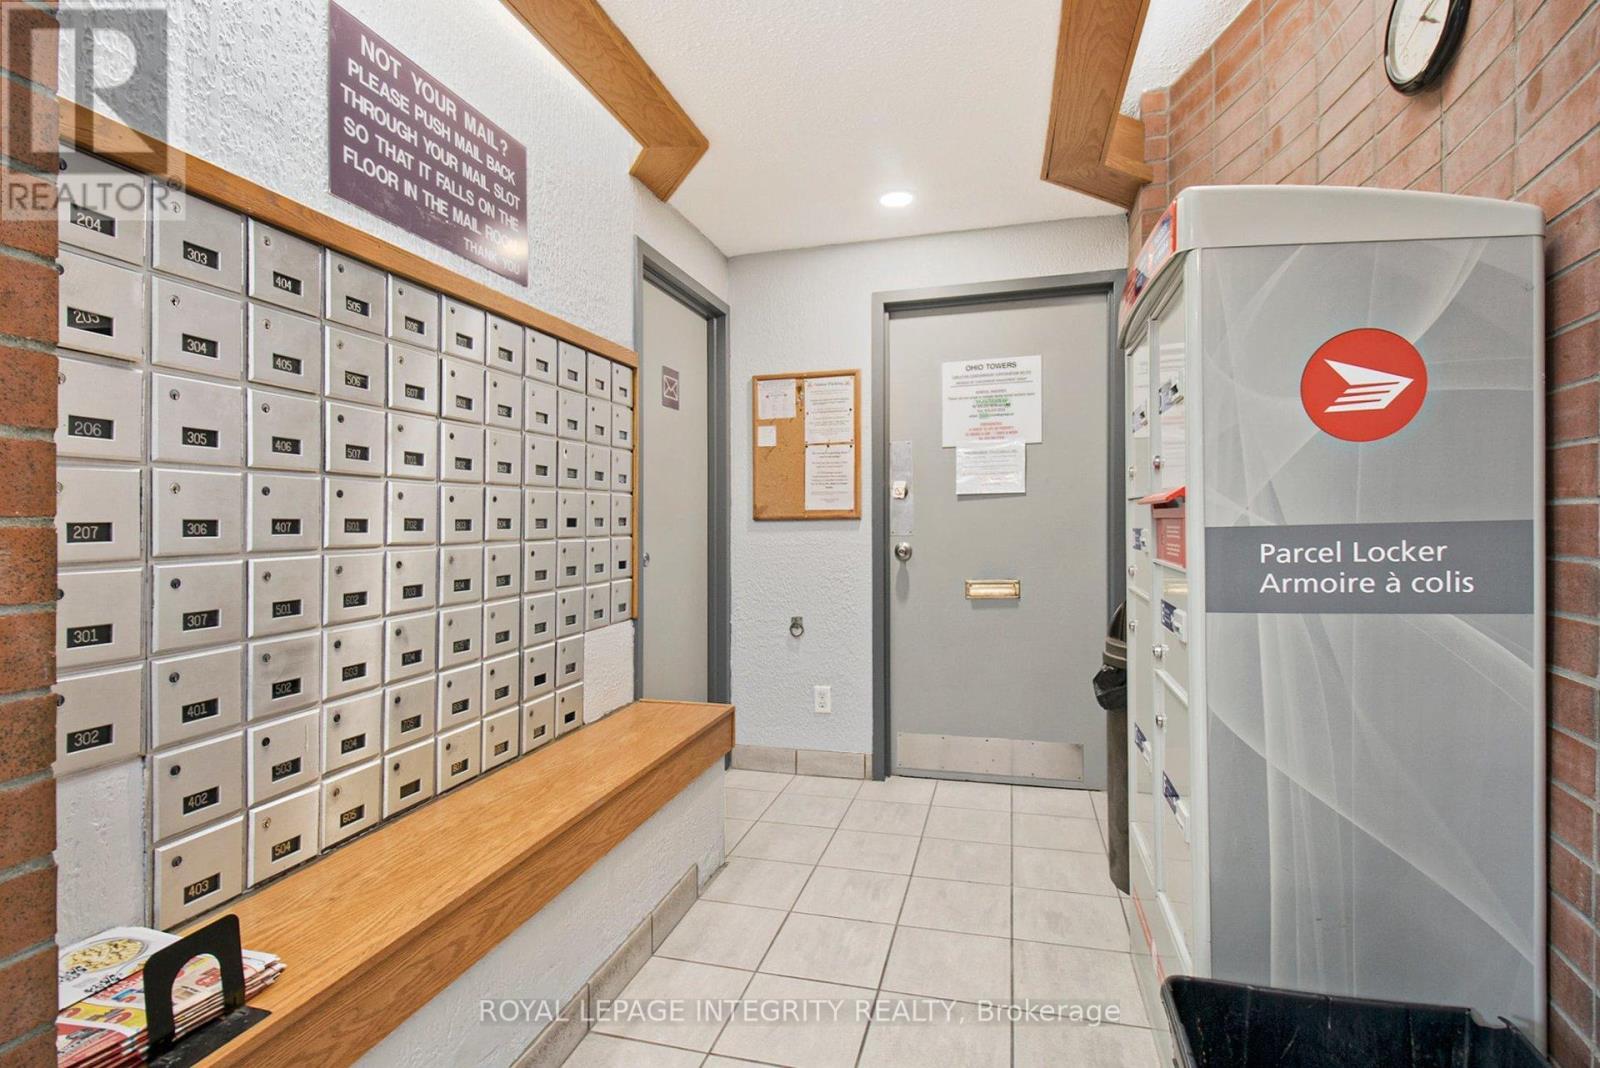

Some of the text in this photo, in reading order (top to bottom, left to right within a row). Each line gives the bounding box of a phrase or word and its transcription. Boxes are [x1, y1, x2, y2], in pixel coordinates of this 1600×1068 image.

[361, 34, 508, 156] NOT YOUR MAIL?
[348, 58, 516, 186] PLEASE PUSH MAIL BACK
[340, 83, 521, 210] THROUGH YOUR MAIL SLOT
[343, 116, 519, 232] SO THAT IT FALLS ON THE
[343, 145, 399, 191] FLOOR
[404, 179, 418, 201] IN
[422, 189, 449, 218] THE
[452, 206, 482, 235] MAIL
[76, 212, 102, 232] 204
[187, 247, 208, 264] 303
[502, 258, 521, 275] YOU
[275, 276, 292, 290] 404
[347, 301, 361, 313] 505
[187, 340, 207, 355] 304
[275, 357, 292, 371] 405
[986, 361, 1017, 370] TOWERS
[347, 374, 361, 387] 506
[73, 421, 102, 437] 206
[187, 431, 208, 446] 305
[274, 440, 292, 453] 406
[347, 447, 361, 460] 507
[72, 525, 98, 540] 207
[187, 522, 207, 535] 306
[274, 521, 291, 534] 407
[1259, 540, 1448, 564] Parcel Locker
[1259, 570, 1475, 593] Armoire à colis
[275, 603, 292, 616] 501
[187, 614, 208, 628] 307
[73, 629, 99, 643] 301
[275, 681, 292, 695] 502
[187, 703, 208, 718] 401
[73, 730, 99, 747] 302
[275, 761, 292, 775] 503
[187, 792, 208, 808] 402
[274, 841, 292, 855] 504
[187, 880, 210, 897] 403
